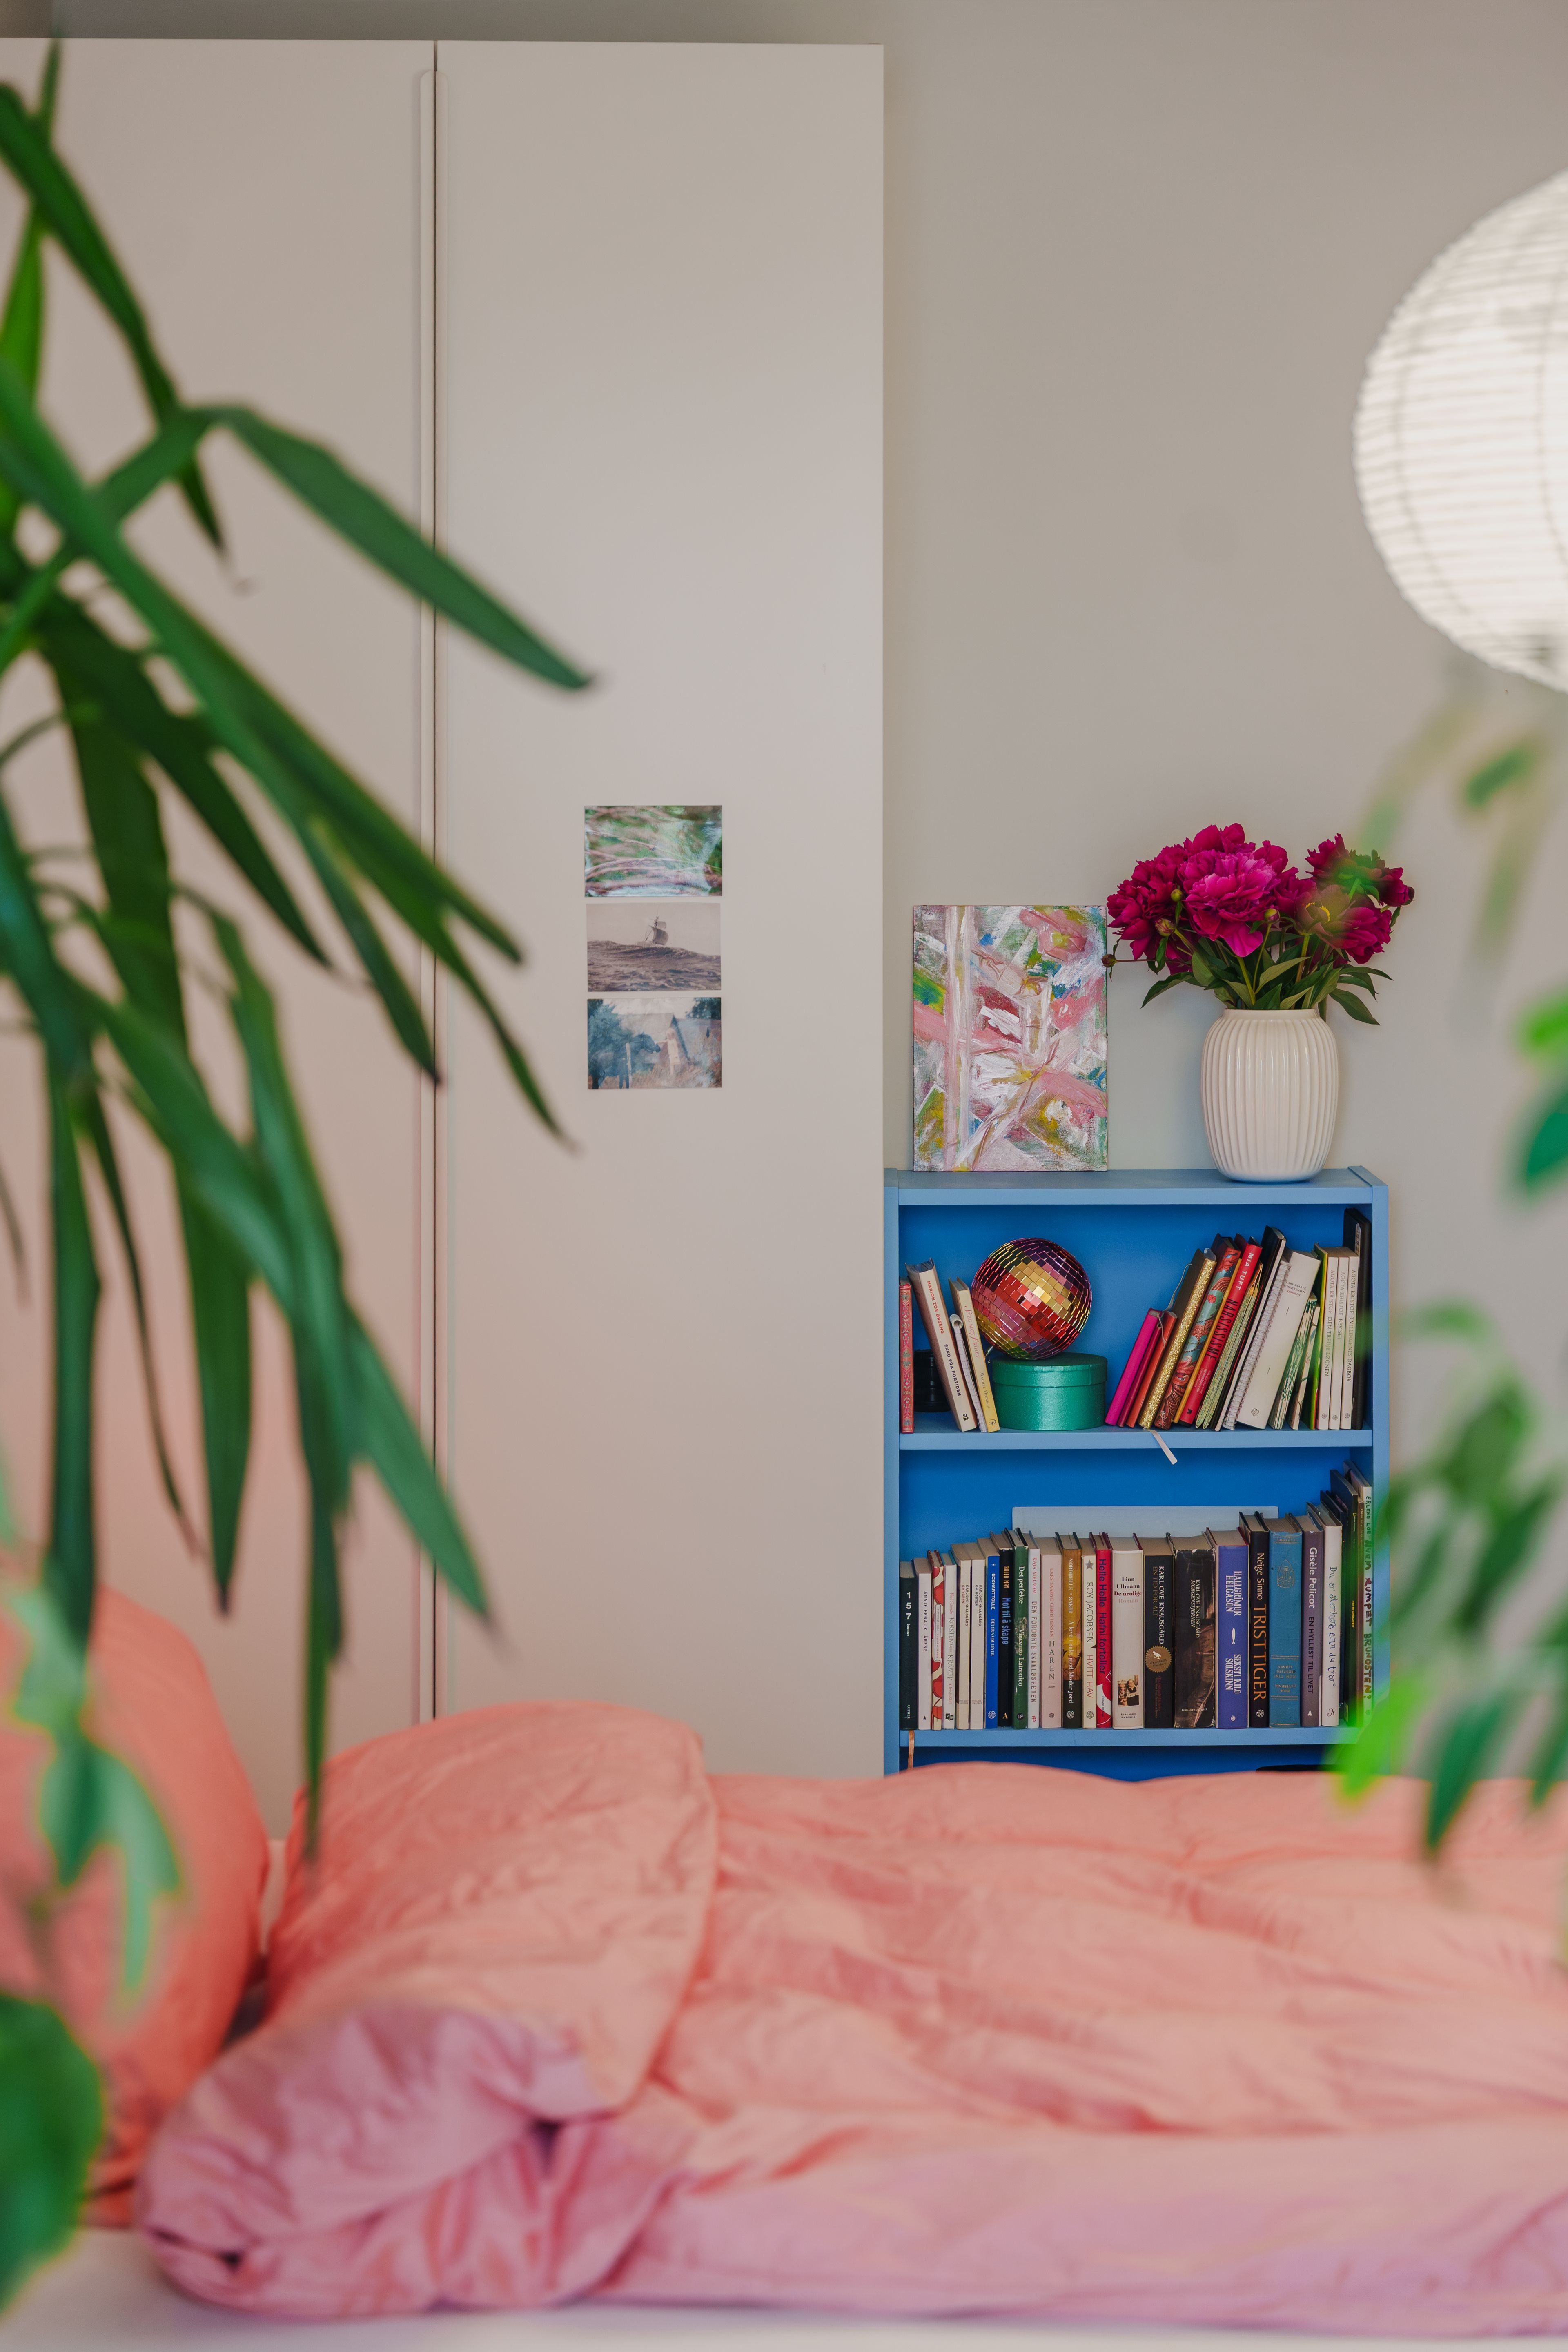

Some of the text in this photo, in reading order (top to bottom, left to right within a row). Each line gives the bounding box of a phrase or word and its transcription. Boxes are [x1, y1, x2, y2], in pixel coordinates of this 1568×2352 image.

[1236, 1252, 1254, 1290] MIA TUFT
[1285, 1285, 1305, 1294] CHRISTENSEN
[936, 1314, 944, 1334] ØRSENG
[1205, 1298, 1239, 1361] NARSISSISME
[951, 1371, 961, 1396] FORTIDEN
[1153, 1566, 1158, 1575] EN
[1254, 1553, 1265, 1575] Neige
[1309, 1547, 1317, 1575] Gisèle
[1329, 1566, 1337, 1579] Du
[1234, 1571, 1243, 1616] HALLGRÍMUR
[1309, 1578, 1317, 1608] Pelicot
[1329, 1582, 1335, 1592] er
[1002, 1597, 1011, 1608] Mot
[1364, 1577, 1372, 1627] RUMPET
[1000, 1625, 1011, 1644] skape
[1085, 1601, 1094, 1643] JACOBSEN
[1098, 1613, 1107, 1635] Hafni
[1254, 1604, 1266, 1649] TRIST
[1309, 1617, 1314, 1626] EN
[1099, 1639, 1107, 1674] forteller
[1329, 1653, 1336, 1662] du
[1363, 1633, 1372, 1699] BRUNOSTEN?
[1225, 1658, 1234, 1690] SOLSKINN
[1233, 1654, 1242, 1694] SEKSTI KILO
[1253, 1651, 1266, 1701] TIGER
[1327, 1666, 1336, 1686] tror
